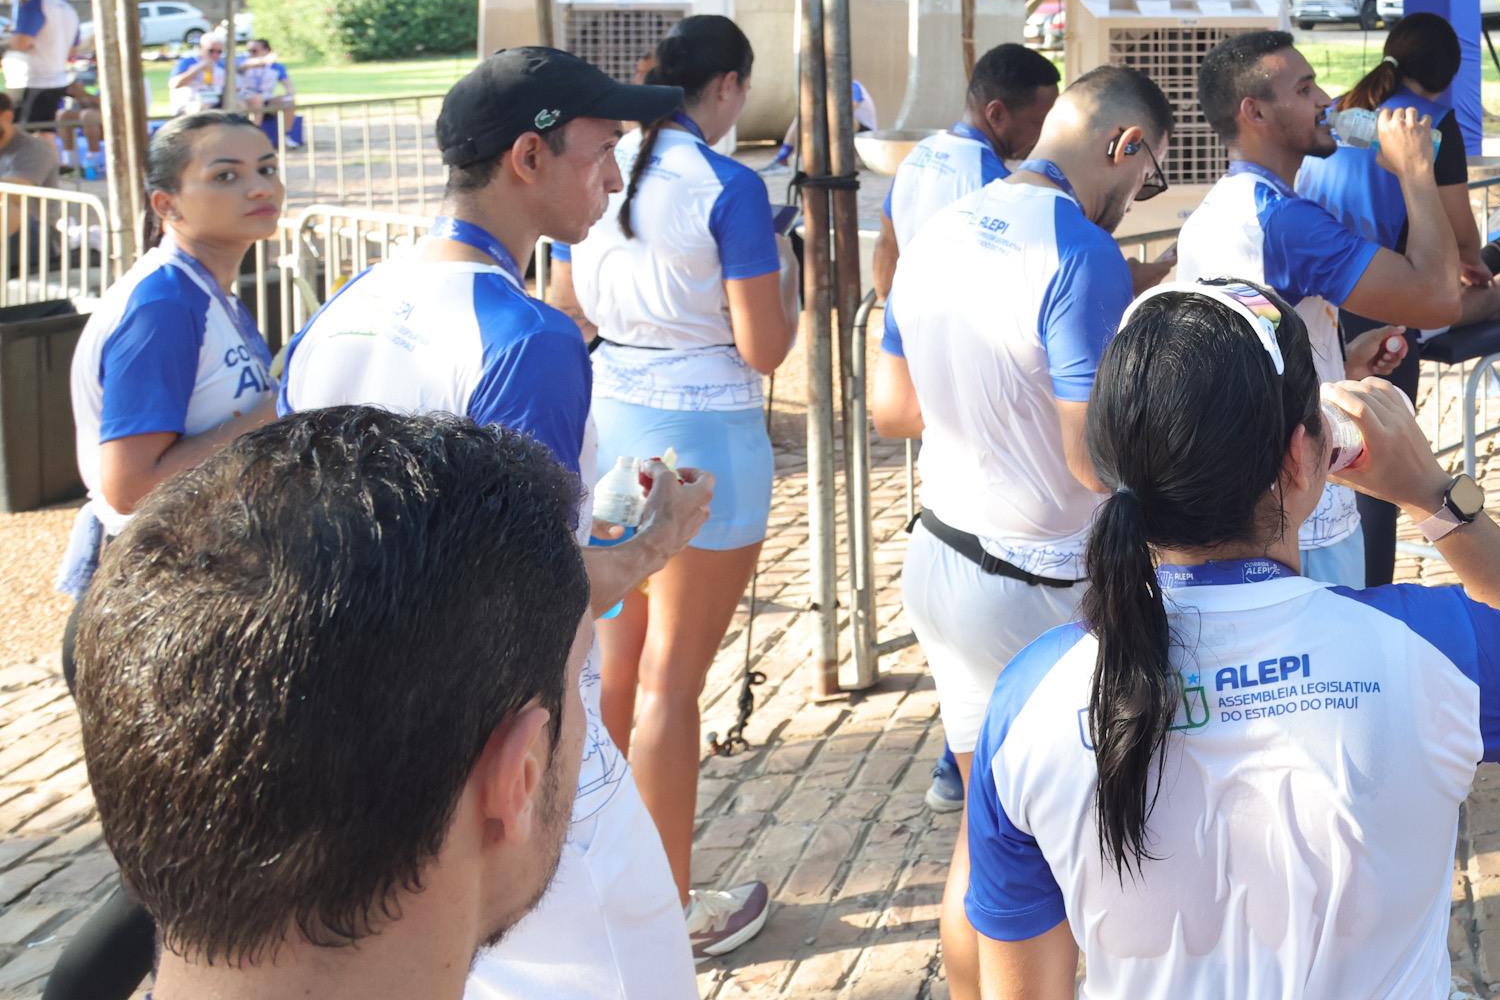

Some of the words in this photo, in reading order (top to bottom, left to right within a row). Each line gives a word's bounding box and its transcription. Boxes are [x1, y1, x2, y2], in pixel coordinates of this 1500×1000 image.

[1245, 567, 1270, 575] ALEPI
[1215, 653, 1311, 692] ALEPI
[1218, 685, 1298, 708] ASSEMBLEIA
[1301, 681, 1381, 696] LEGISLATIVA
[1221, 710, 1242, 723] DO
[1245, 702, 1297, 720] ESTADO
[1300, 698, 1322, 712] DO
[1325, 696, 1359, 710] PIAUÍ
